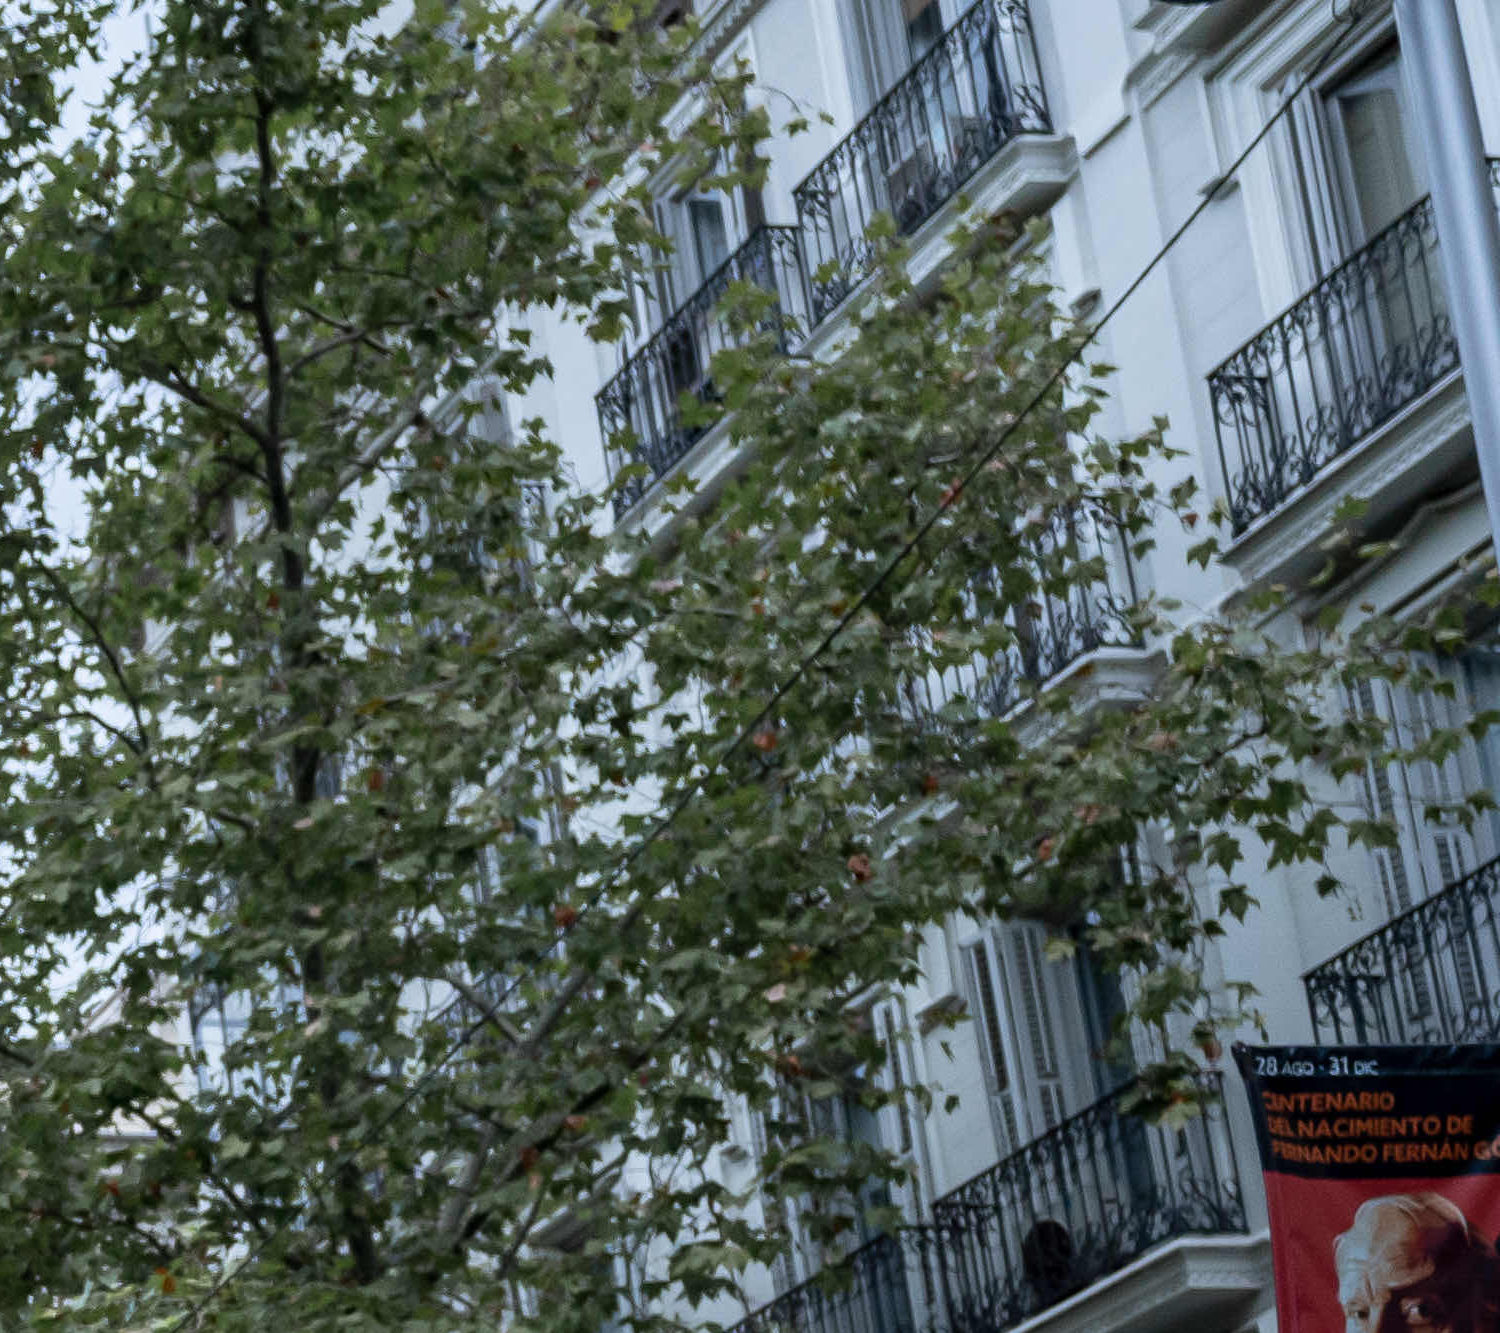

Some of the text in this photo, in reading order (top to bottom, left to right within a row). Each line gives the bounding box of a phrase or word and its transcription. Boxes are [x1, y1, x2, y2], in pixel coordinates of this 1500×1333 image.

[1255, 1056, 1277, 1076] 28
[1281, 1061, 1314, 1075] AGO
[1328, 1056, 1348, 1075] 31
[1297, 1116, 1441, 1138] NACIMIENTO
[1446, 1115, 1473, 1134] DE
